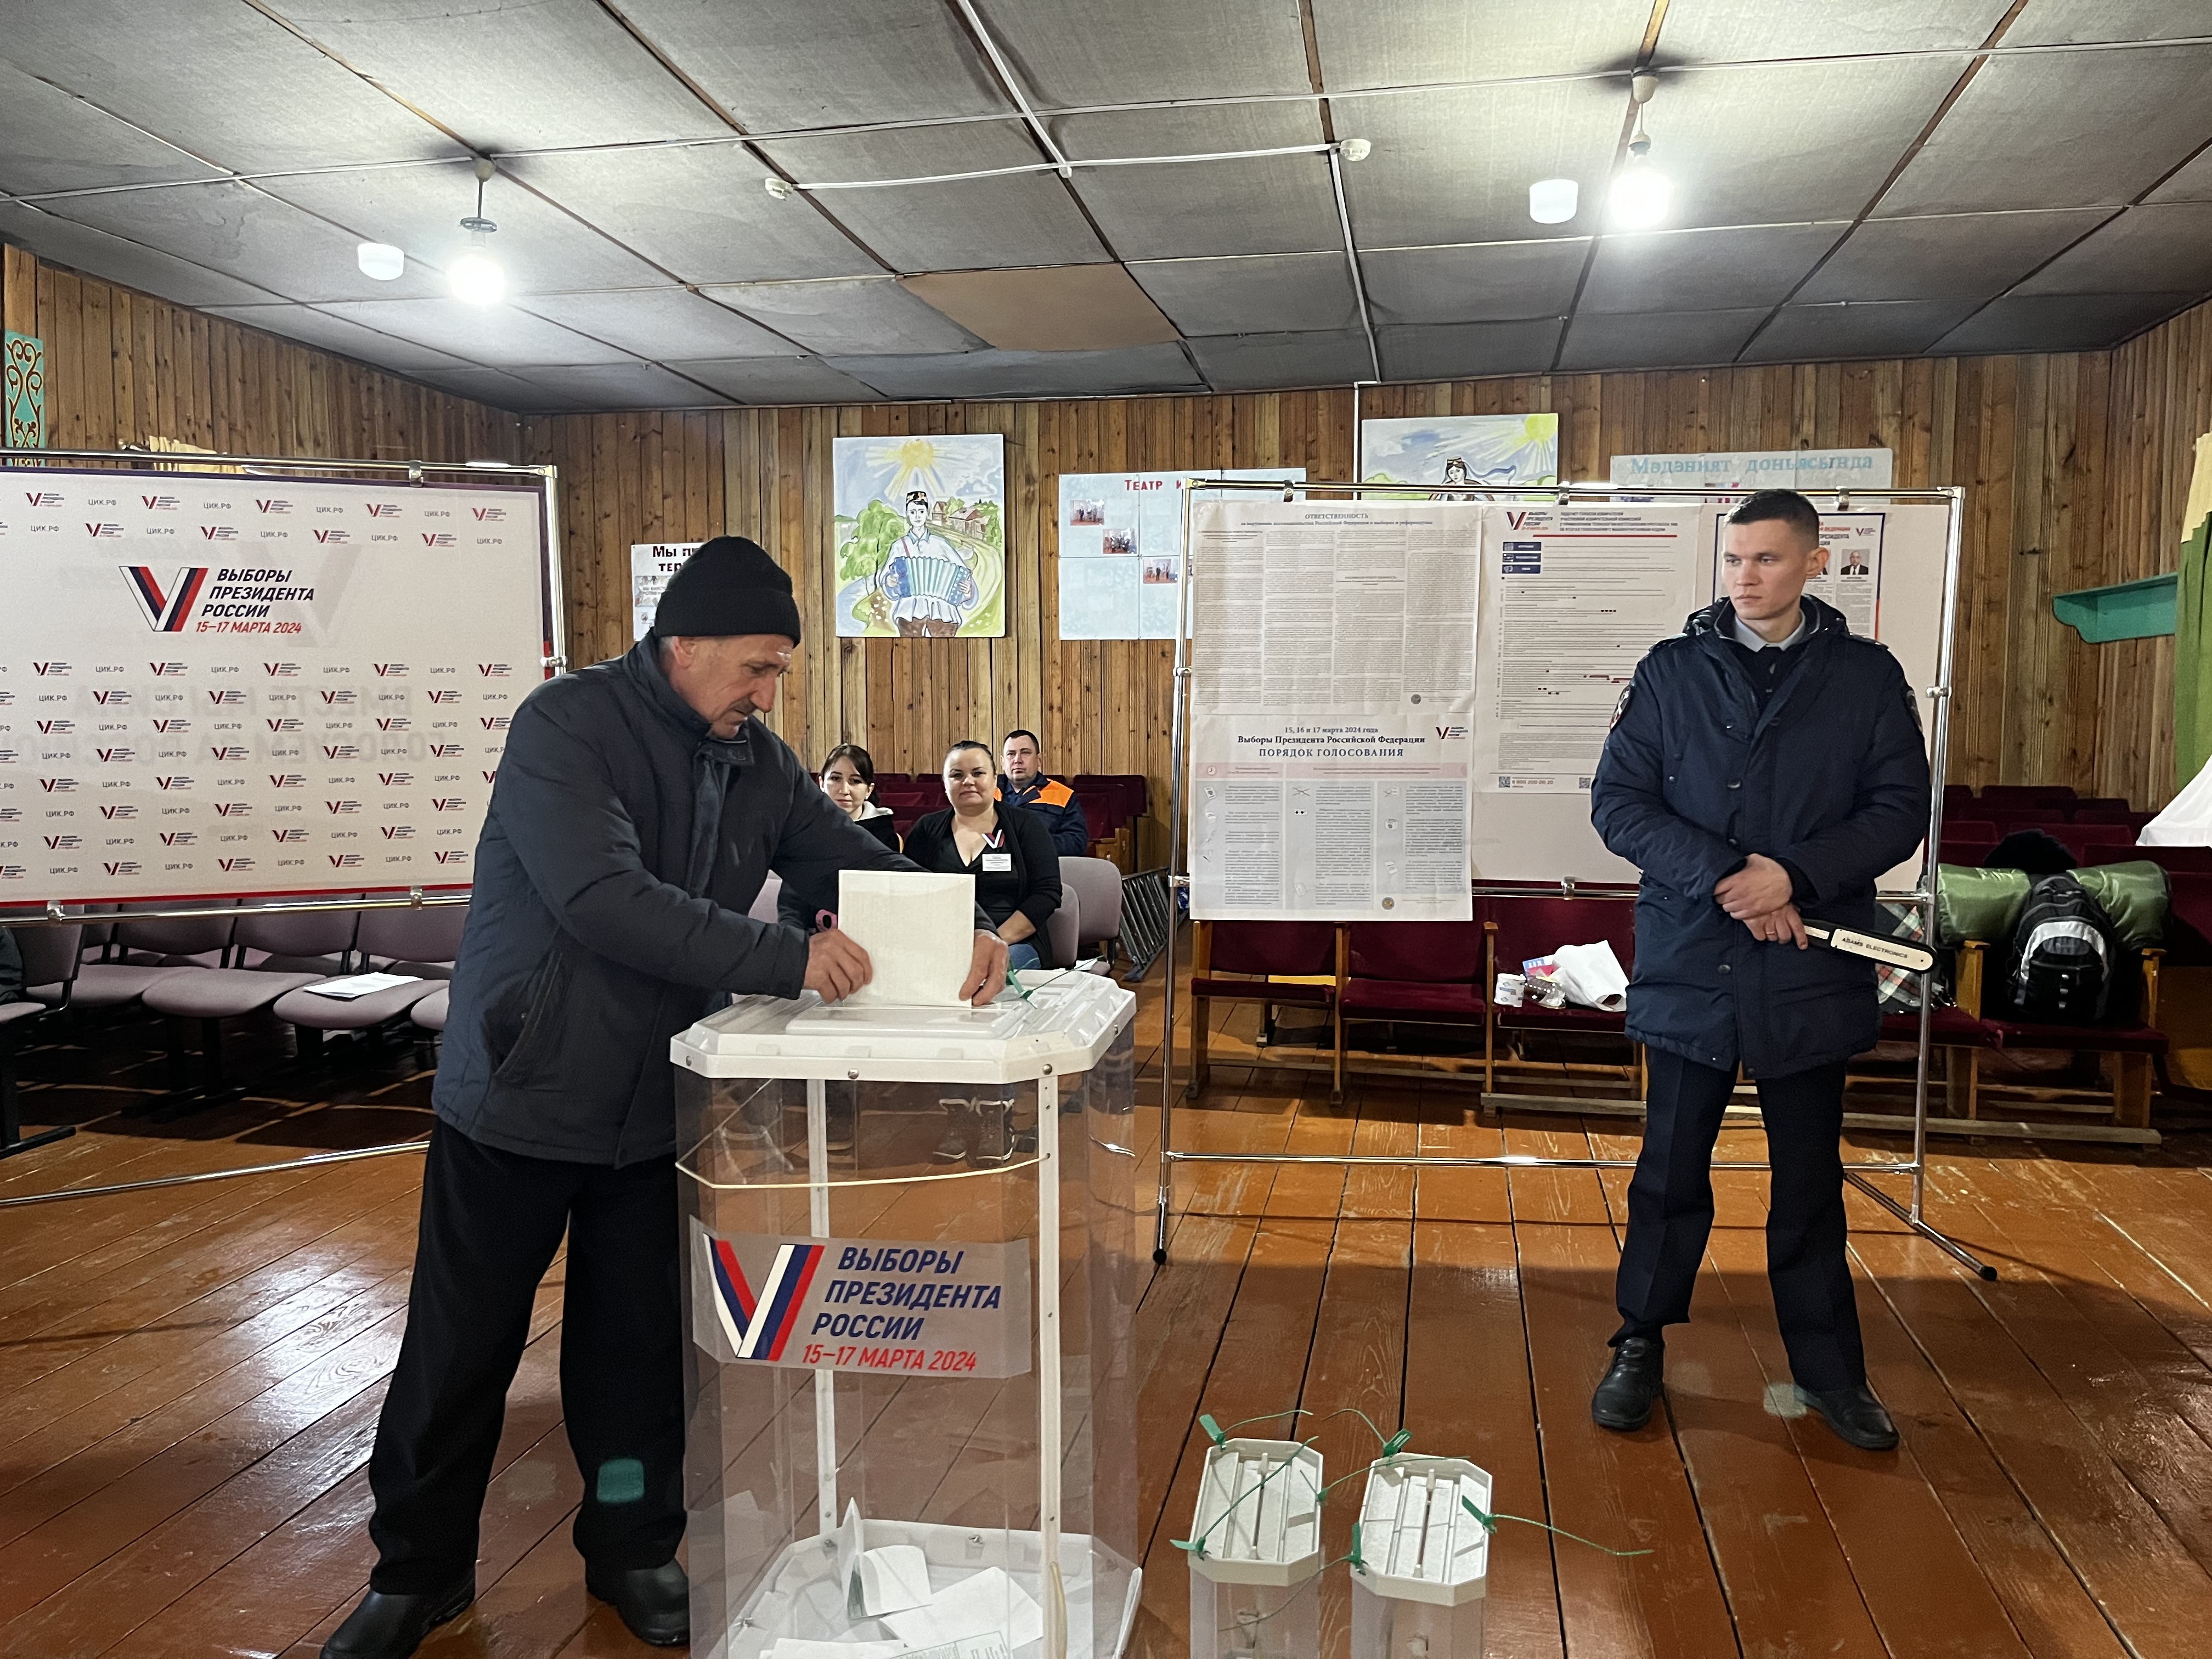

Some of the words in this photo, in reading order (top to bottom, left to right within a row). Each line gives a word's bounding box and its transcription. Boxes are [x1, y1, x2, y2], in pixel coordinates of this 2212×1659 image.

[652, 546, 676, 558] Мы
[217, 568, 292, 583] ВЫБОРЫ
[209, 586, 315, 601] ПРЕЗИДЕНТА
[201, 604, 270, 618] РОССИИ
[231, 622, 270, 634] МАРТА
[273, 622, 302, 634] 2024
[1238, 736, 1273, 745] Выборы
[1275, 736, 1324, 745] Президента
[1378, 736, 1425, 744] Федерации
[1259, 749, 1313, 758] ПОРЯДОК
[1317, 749, 1404, 757] ГОЛОСОВАНИЯ
[1865, 944, 1908, 959] ELECTRONICS
[837, 1246, 964, 1274] ВЫБОРЫ
[824, 1280, 1002, 1311] ПРЕЗИДЕНТА
[811, 1312, 924, 1340] РОССИИ
[858, 1347, 925, 1370] МАРТА
[928, 1350, 978, 1372] 2024
